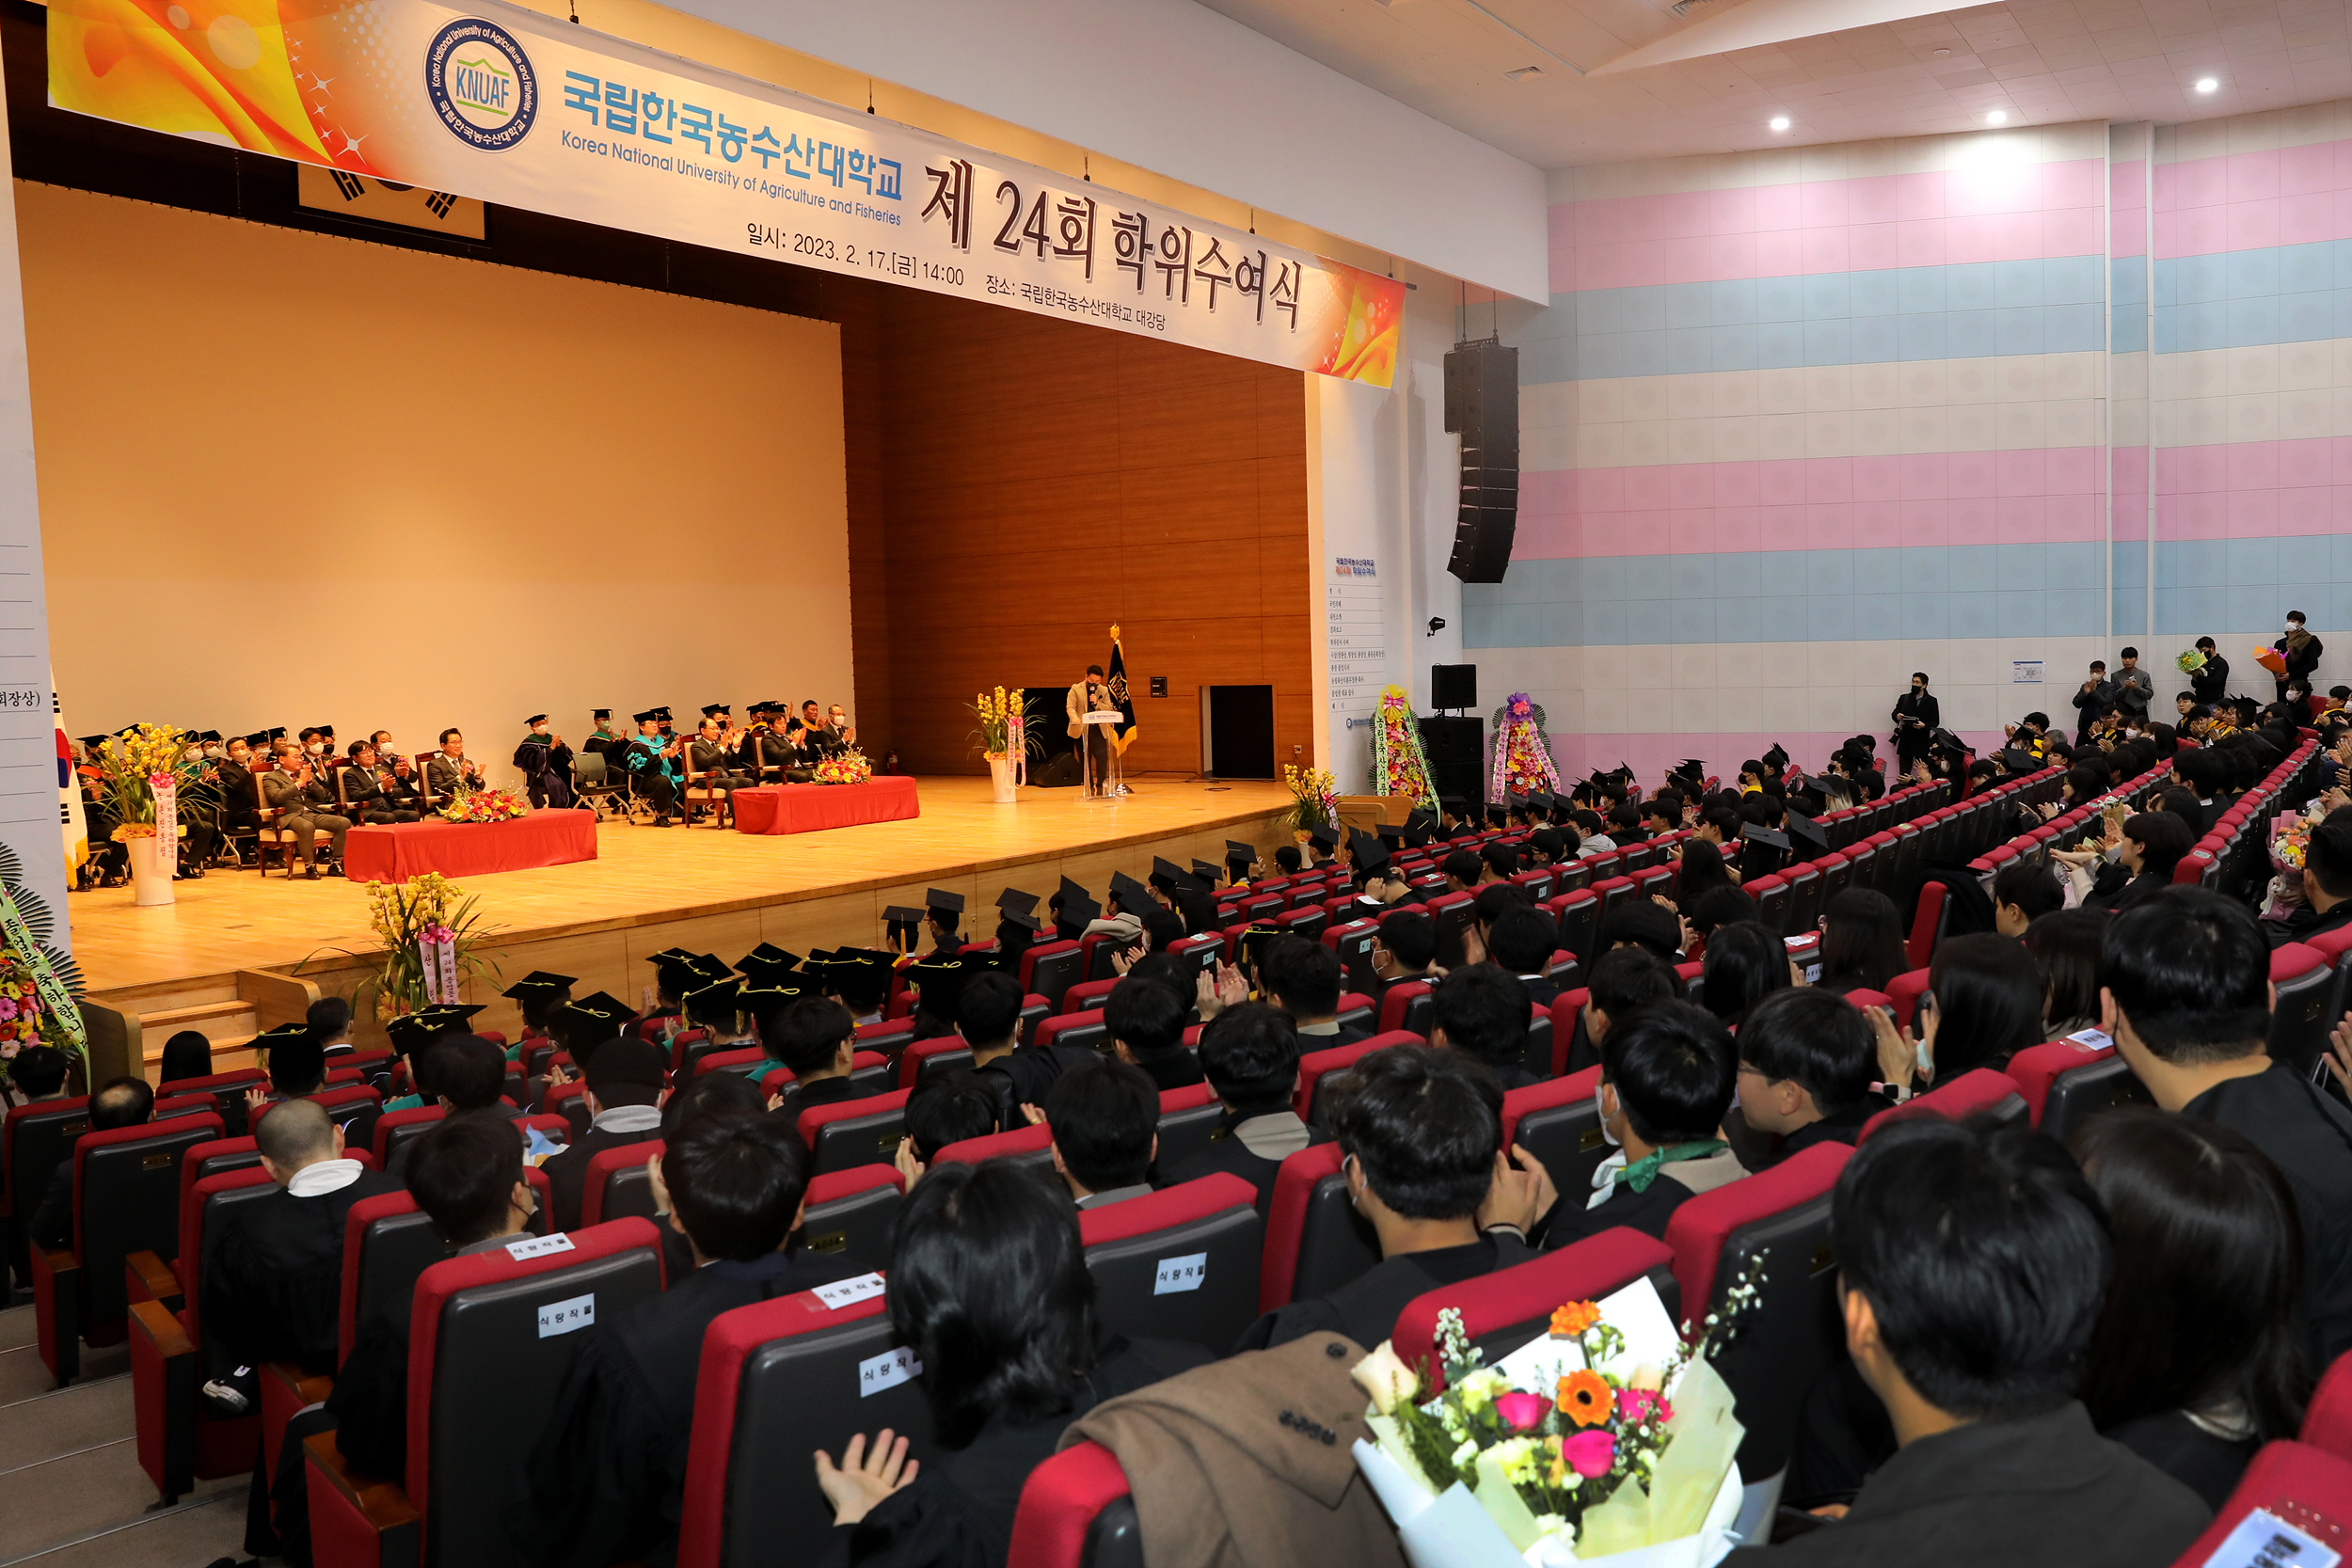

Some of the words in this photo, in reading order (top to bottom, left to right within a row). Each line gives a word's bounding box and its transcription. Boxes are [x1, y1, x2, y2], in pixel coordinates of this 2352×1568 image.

[433, 33, 453, 63] National
[450, 24, 482, 41] University
[482, 27, 491, 38] of
[489, 30, 522, 64] Agriculture
[432, 62, 441, 87] Korea
[456, 66, 509, 108] KNUAF
[518, 63, 532, 82] and
[523, 80, 533, 113] Fisheries
[438, 99, 527, 146] 국립한국농수산대학교
[564, 70, 902, 201] 국립한국농수산대학교
[562, 130, 608, 156] Korea
[612, 142, 673, 171] National
[677, 158, 739, 190] University
[743, 177, 757, 191] of
[759, 180, 826, 208] Agriculture
[829, 198, 852, 214] and
[855, 202, 901, 226] Fisheries
[747, 222, 786, 249] 일시:
[794, 233, 839, 261] 2023.
[846, 245, 861, 266] 2.
[867, 249, 917, 278] 17.[금]
[923, 261, 964, 286] 14:00
[920, 159, 974, 250] 제
[993, 180, 1097, 280] 24회
[1111, 211, 1303, 330] 학위수여식
[986, 274, 1016, 296] 장소:
[1020, 282, 1133, 323] 국립한국농수산대학교
[1136, 309, 1167, 331] 대강당
